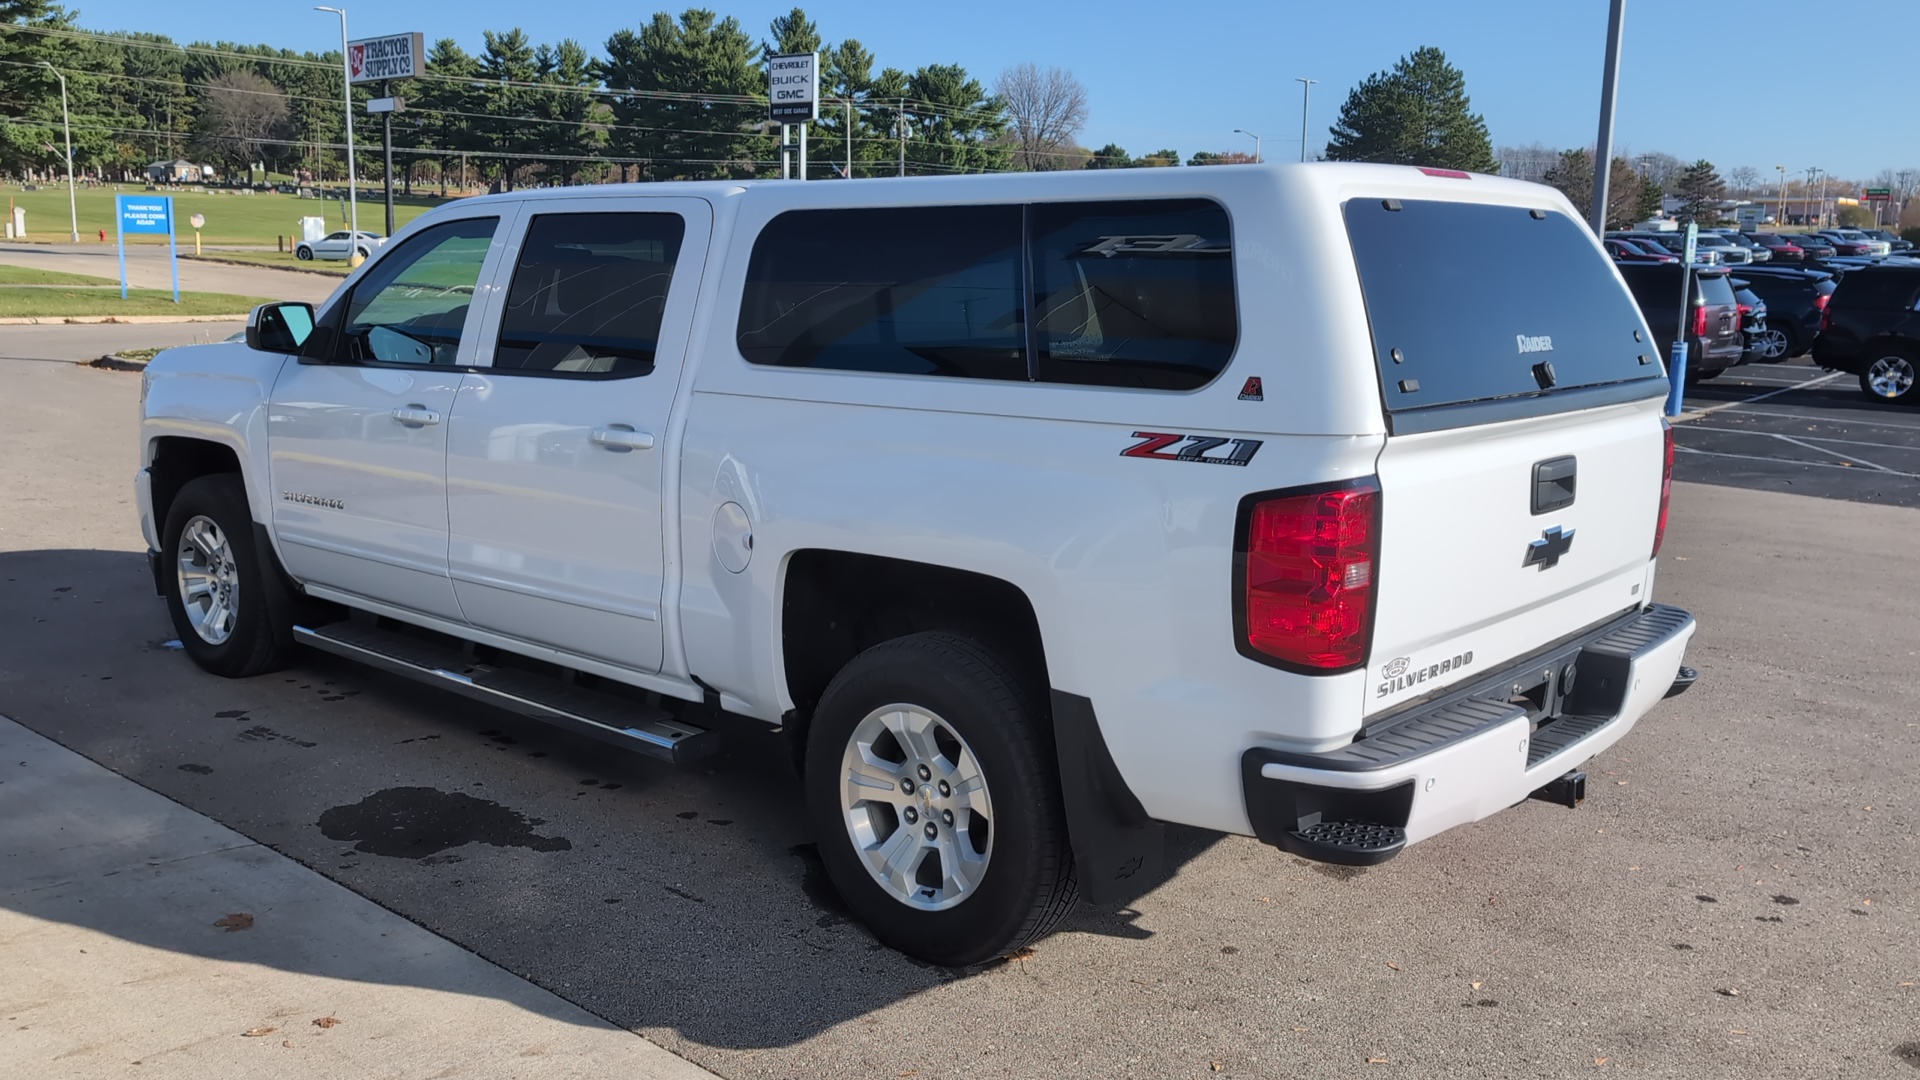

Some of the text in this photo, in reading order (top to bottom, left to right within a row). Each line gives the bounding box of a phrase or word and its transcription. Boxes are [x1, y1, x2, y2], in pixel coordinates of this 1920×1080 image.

[364, 37, 409, 60] TRACTOR
[365, 58, 399, 78] SUPPLY
[772, 60, 809, 70] CHEVROLET
[772, 75, 809, 85] BUICK
[777, 89, 804, 100] GMC
[1516, 334, 1554, 354] RAIDER
[1119, 431, 1264, 466] Z71
[1206, 457, 1246, 466] ROAD
[1376, 650, 1474, 699] SILVERADO
